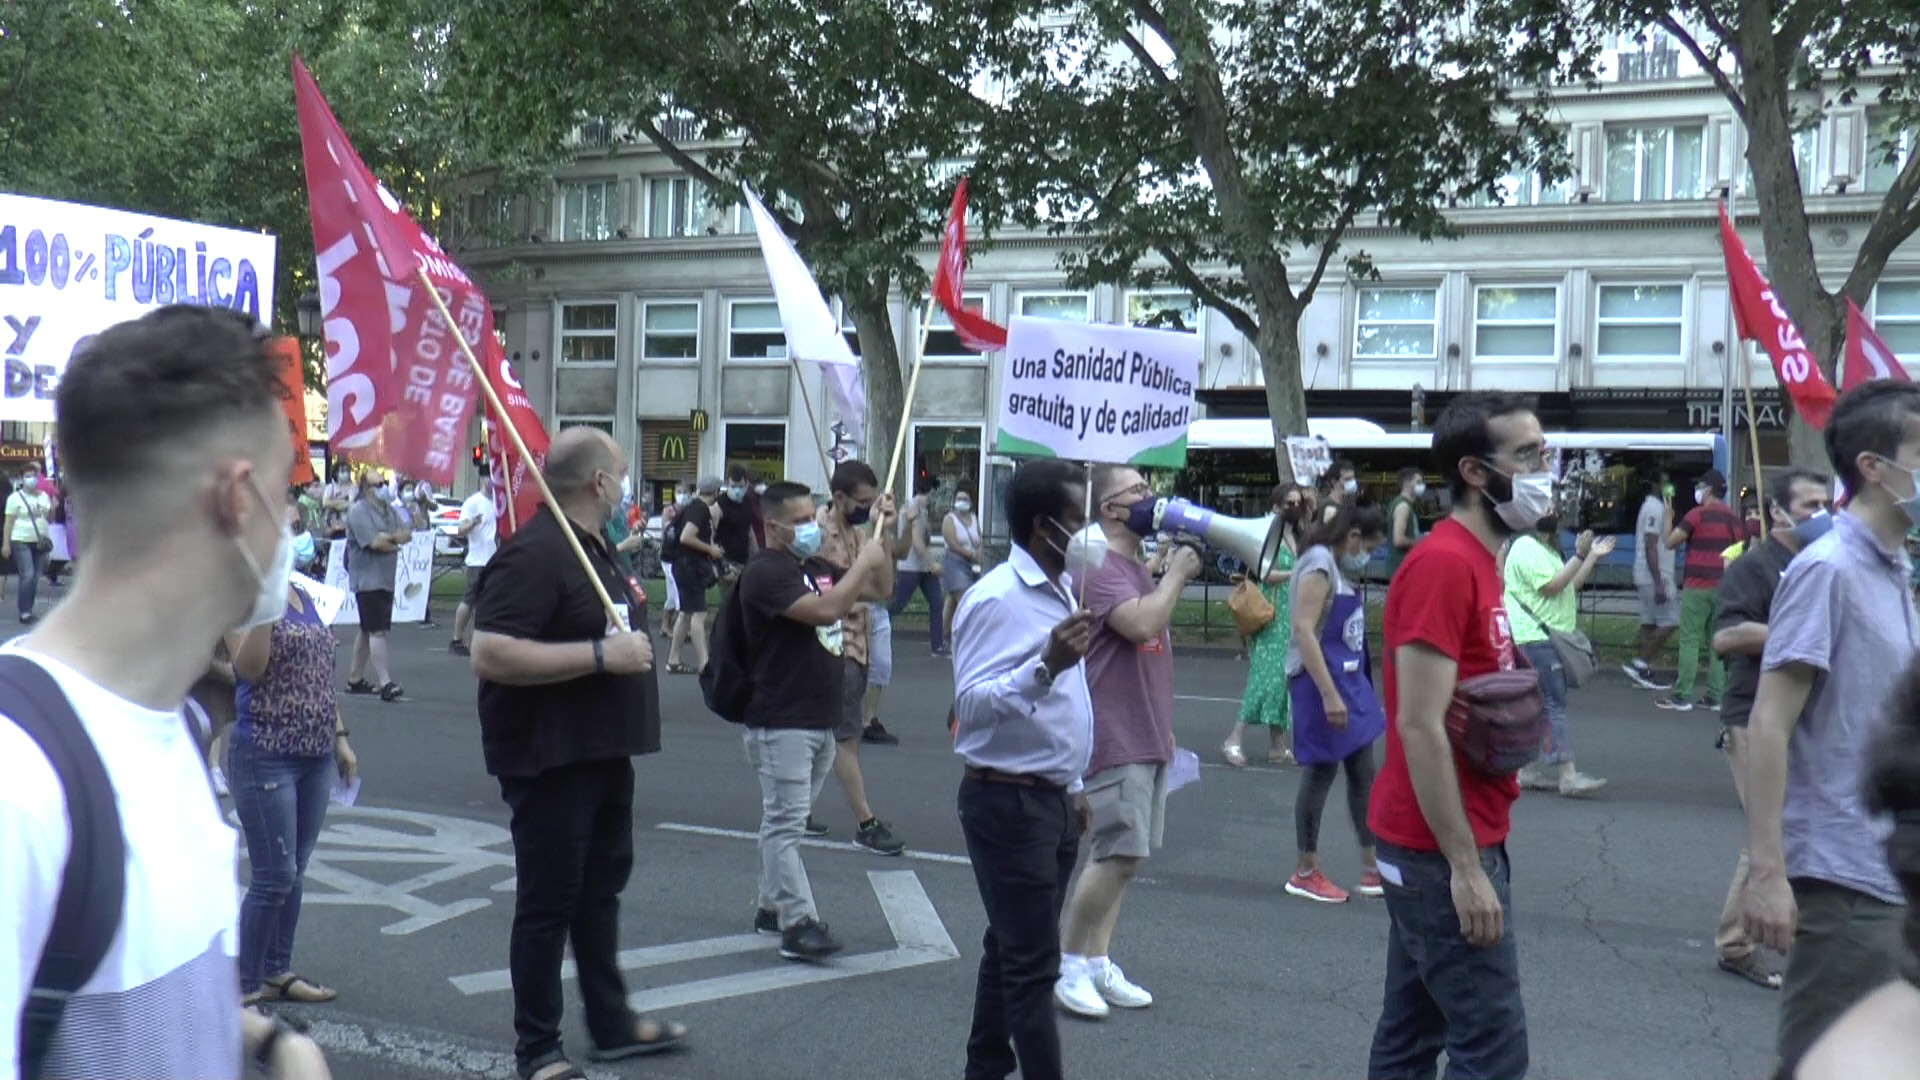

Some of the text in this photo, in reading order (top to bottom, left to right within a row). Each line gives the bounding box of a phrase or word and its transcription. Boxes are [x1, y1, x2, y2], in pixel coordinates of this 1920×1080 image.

[0, 225, 97, 290] 100%
[3, 314, 41, 355] Y
[1052, 346, 1126, 383] Sanidad
[1129, 351, 1192, 397] Pública
[1008, 392, 1189, 440] gratuita y de calidad!
